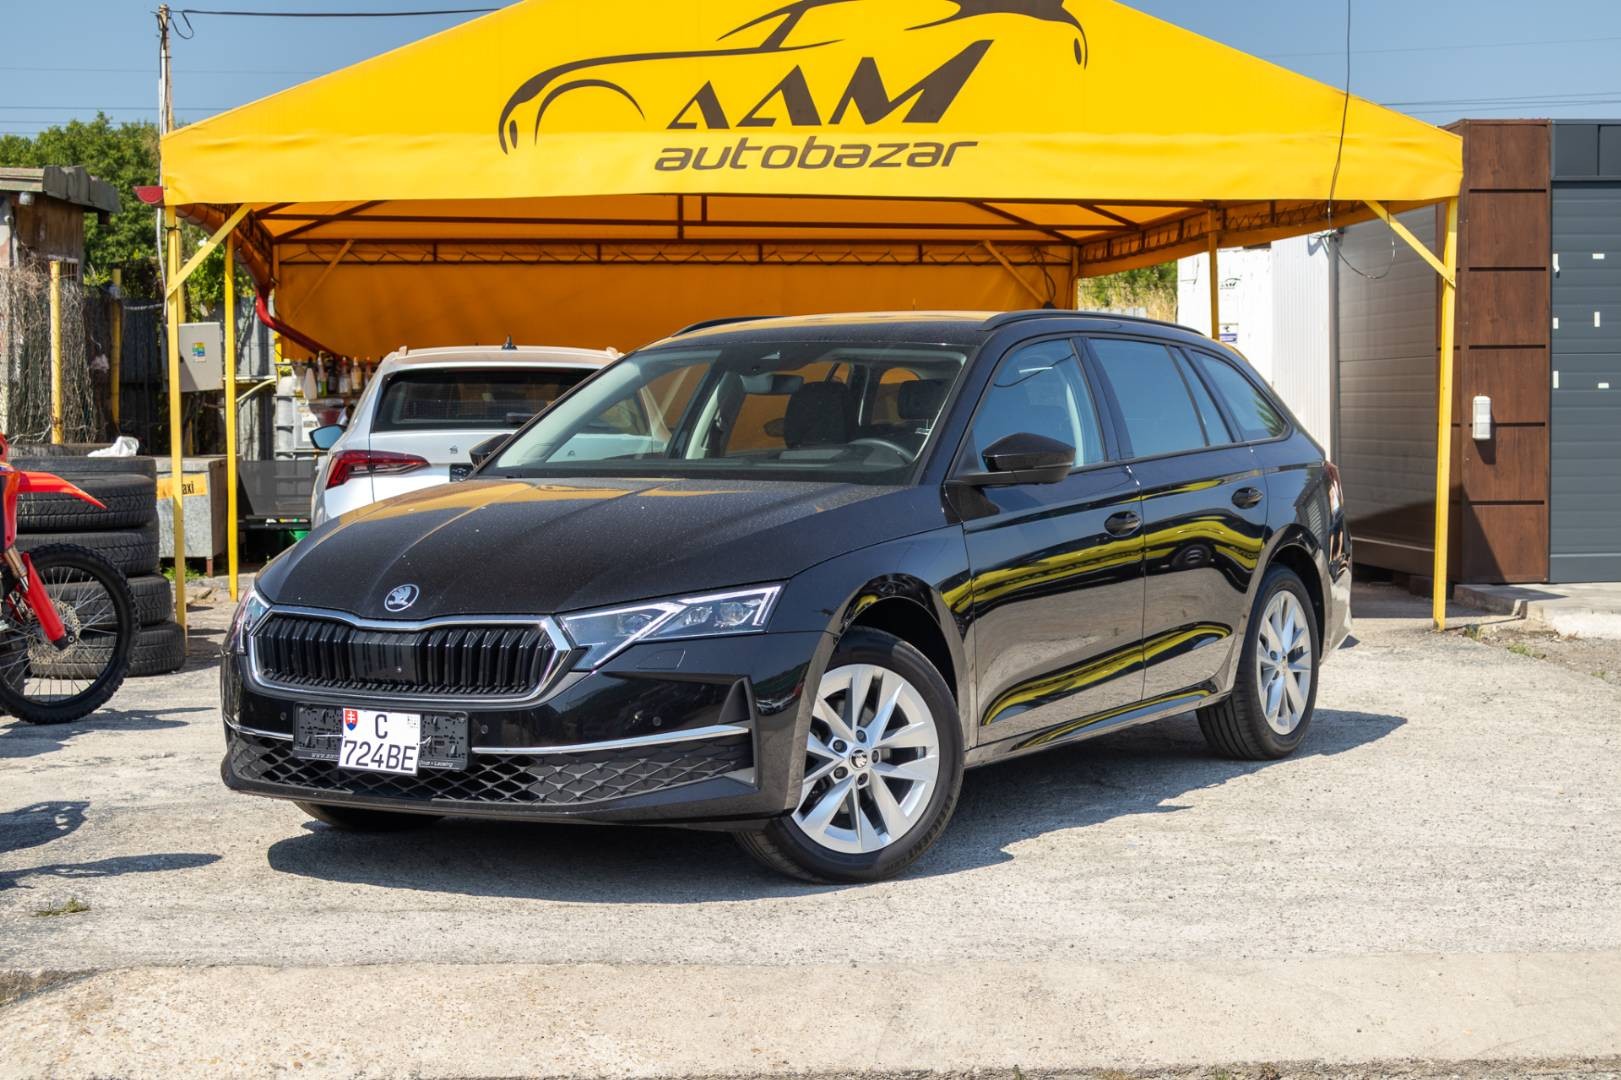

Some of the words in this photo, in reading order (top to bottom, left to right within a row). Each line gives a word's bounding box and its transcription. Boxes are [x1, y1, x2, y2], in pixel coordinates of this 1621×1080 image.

[666, 39, 994, 129] AAM
[654, 136, 978, 171] autobazar
[182, 480, 195, 495] axi
[375, 714, 388, 739] C
[344, 740, 417, 771] 724BE
